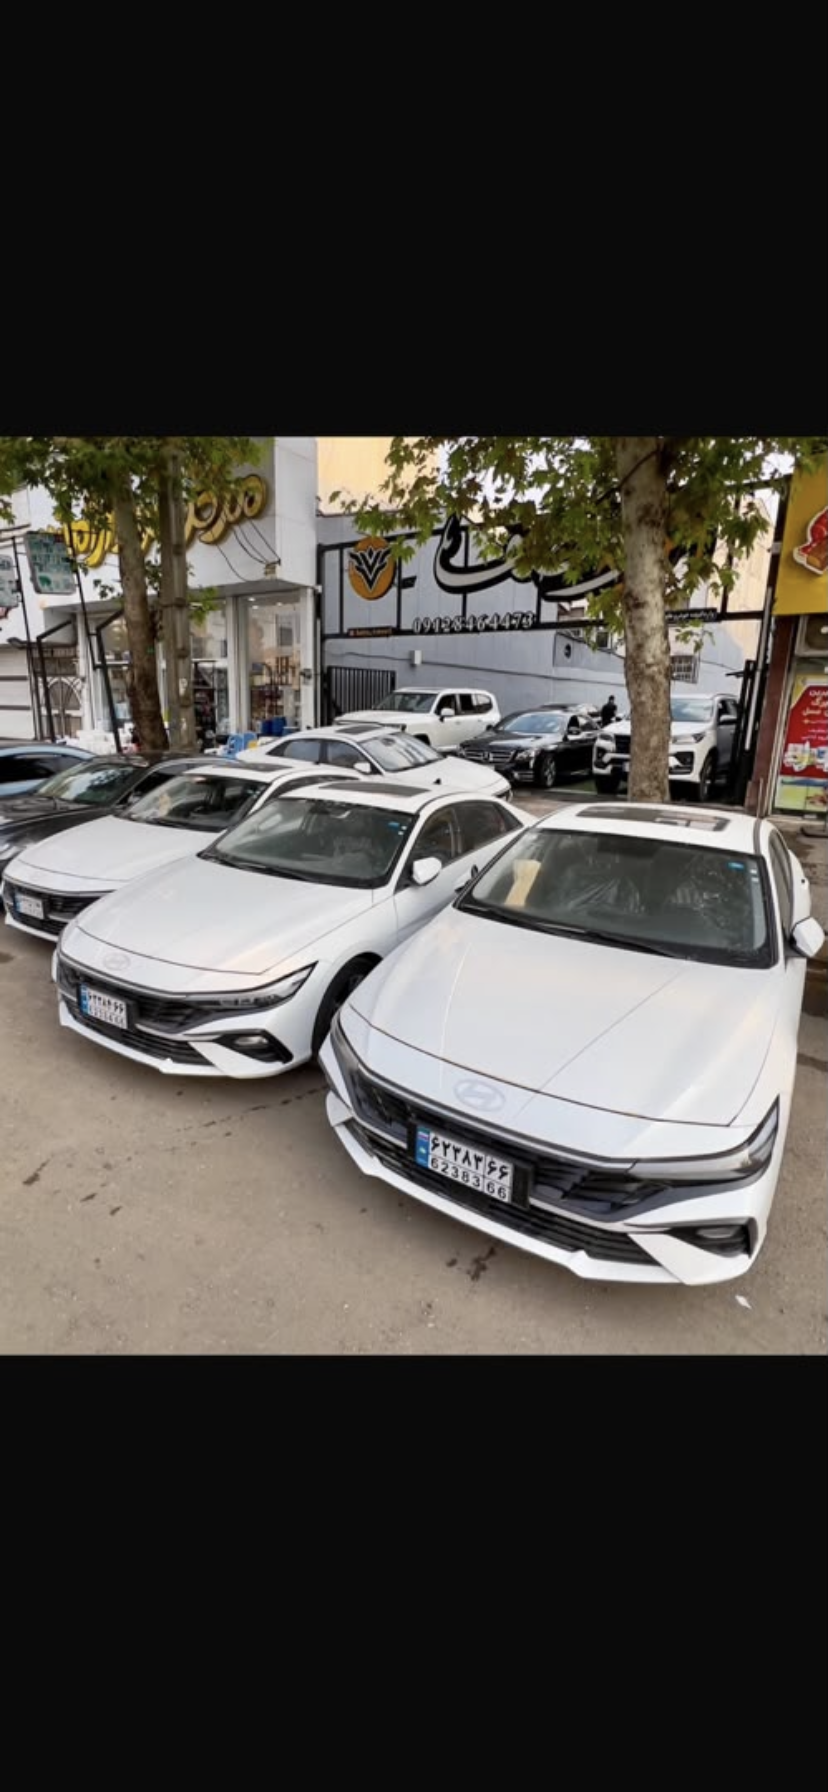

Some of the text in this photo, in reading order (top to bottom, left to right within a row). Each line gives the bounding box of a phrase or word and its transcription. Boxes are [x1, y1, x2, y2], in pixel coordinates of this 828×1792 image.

[413, 611, 535, 634] 09128464473
[430, 1157, 507, 1199] 62383 66
[487, 1160, 509, 1181] ۶۶
